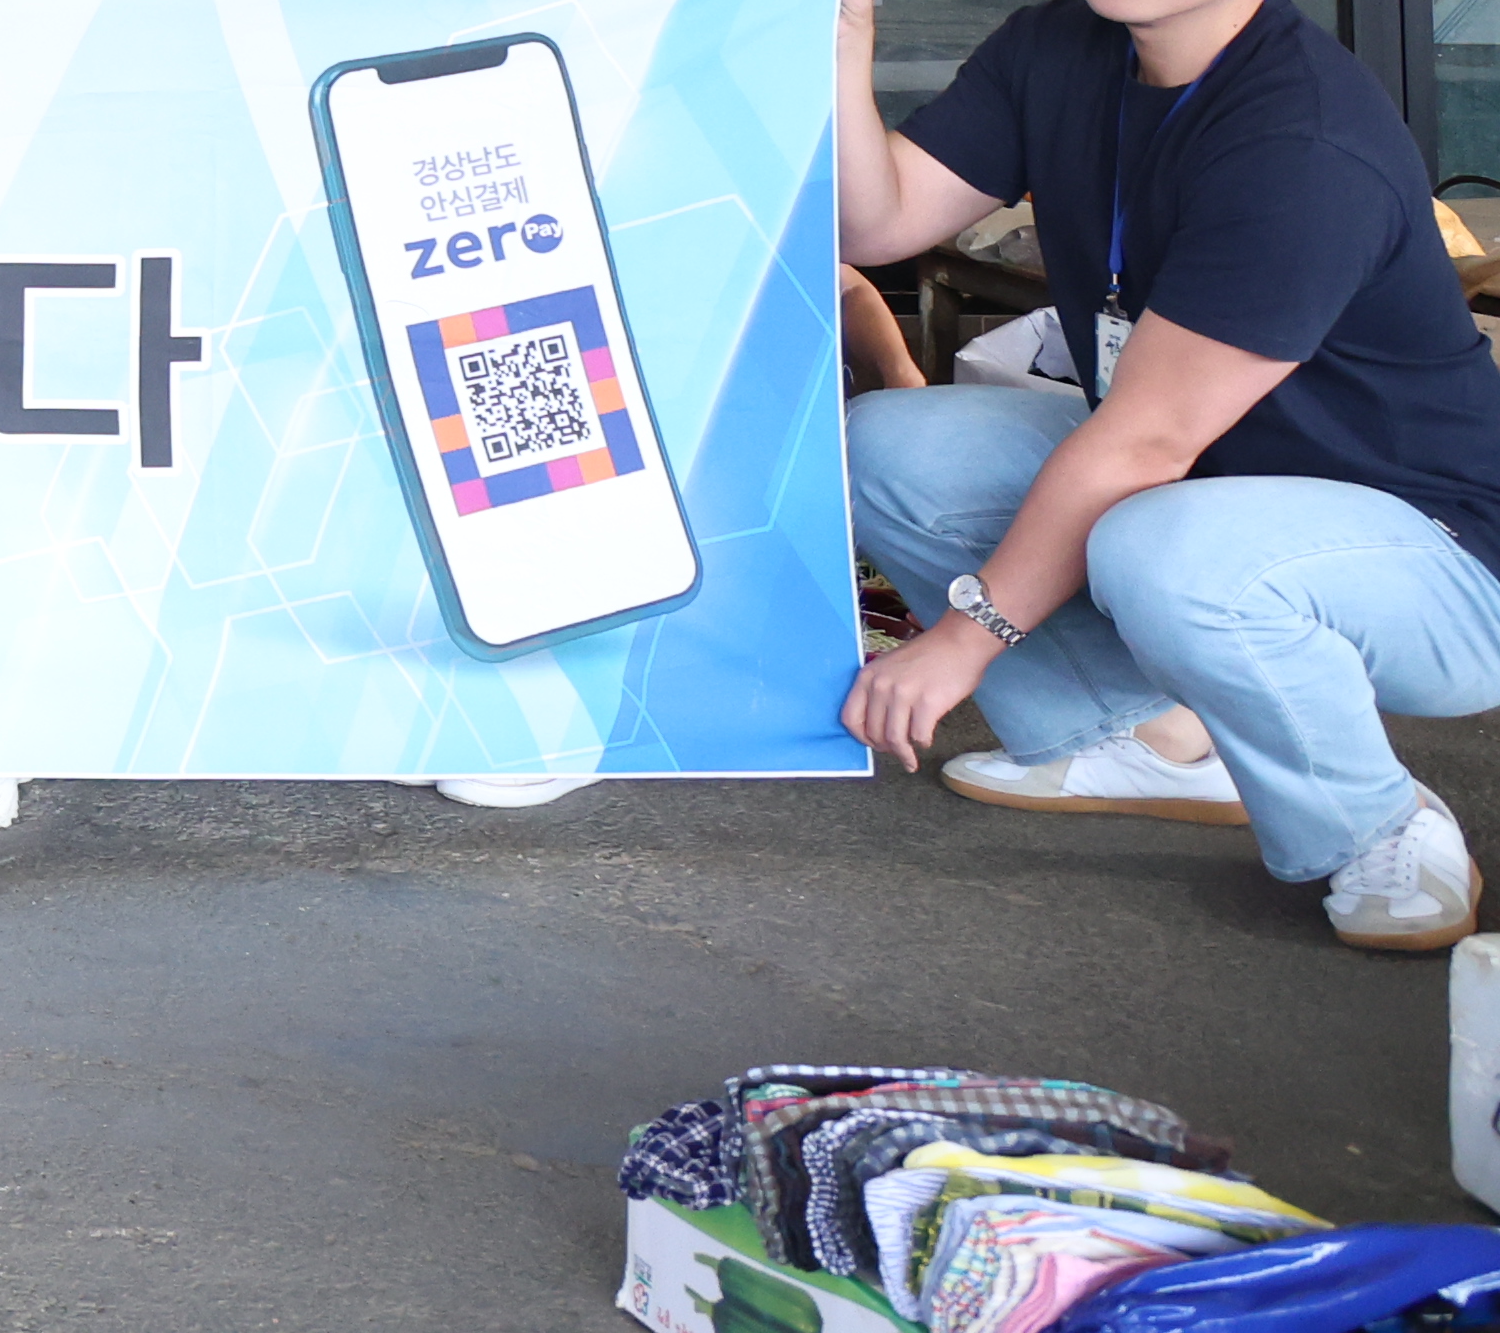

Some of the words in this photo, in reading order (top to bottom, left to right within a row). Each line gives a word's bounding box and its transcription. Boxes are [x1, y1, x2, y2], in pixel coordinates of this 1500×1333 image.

[412, 143, 522, 187] 경상남도
[419, 175, 530, 222] 안심결제
[524, 221, 563, 241] Pay
